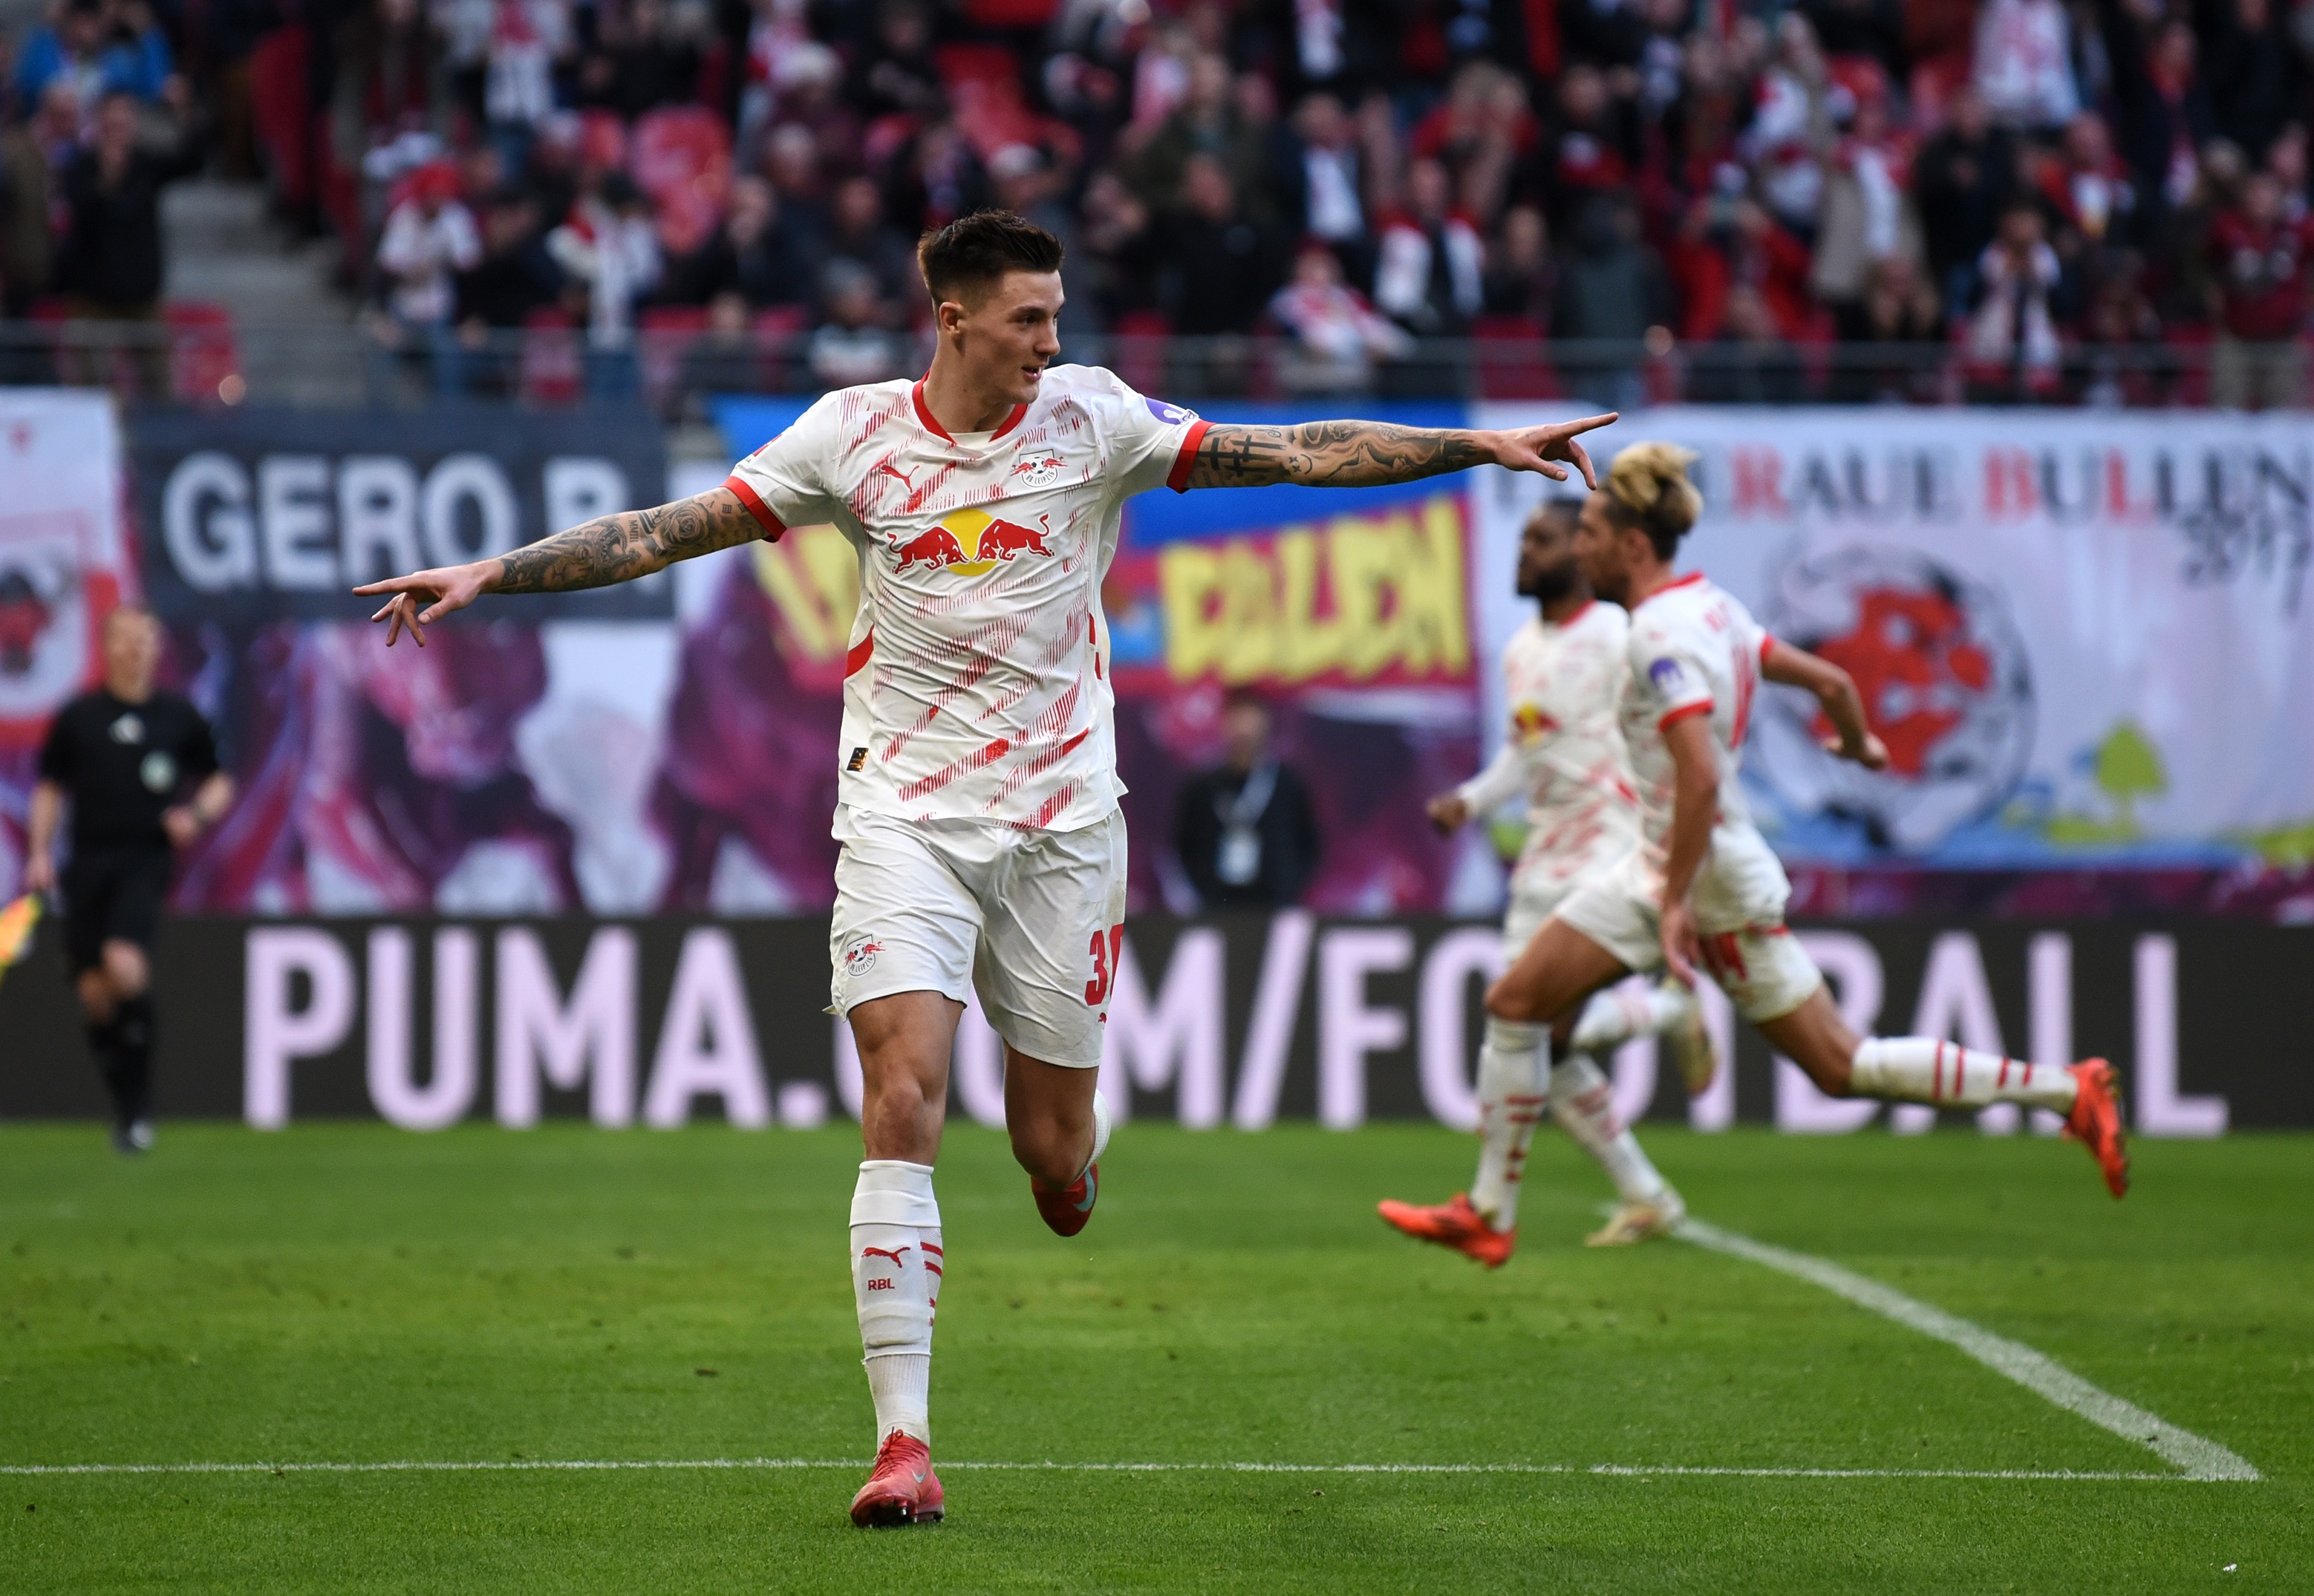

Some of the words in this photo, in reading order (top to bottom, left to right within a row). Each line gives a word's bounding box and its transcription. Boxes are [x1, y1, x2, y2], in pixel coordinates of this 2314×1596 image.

[1034, 470, 1055, 485] LEIPZIG
[161, 451, 518, 591] GERO
[867, 1277, 895, 1291] RBL
